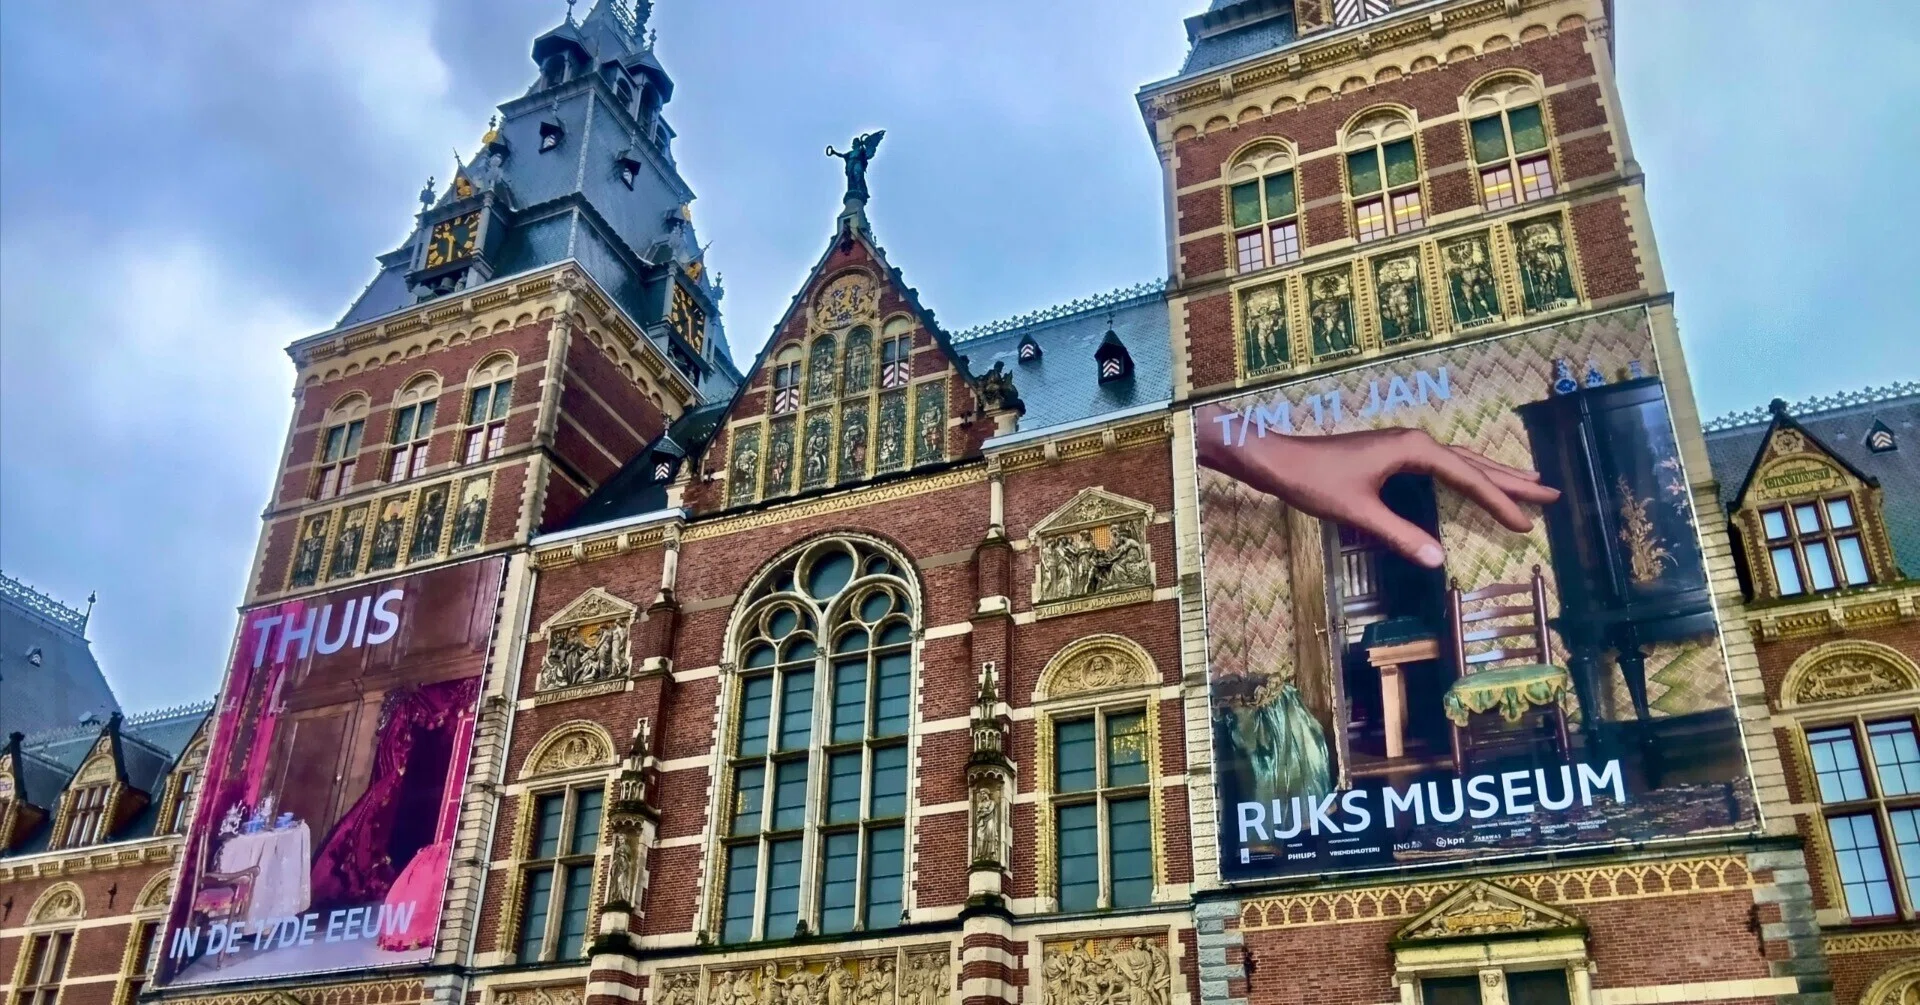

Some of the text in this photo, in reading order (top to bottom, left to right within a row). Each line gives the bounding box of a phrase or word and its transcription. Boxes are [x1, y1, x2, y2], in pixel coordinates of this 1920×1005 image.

[1213, 366, 1451, 447] T/M 11 JAN
[253, 589, 404, 669] THUIS
[1237, 760, 1625, 842] RIJKS MUSEUM
[1287, 852, 1317, 860] PHILIPS
[1393, 842, 1410, 851] ING
[1447, 837, 1465, 846] kpn
[169, 900, 417, 959] IN DE 17DE EEUW
